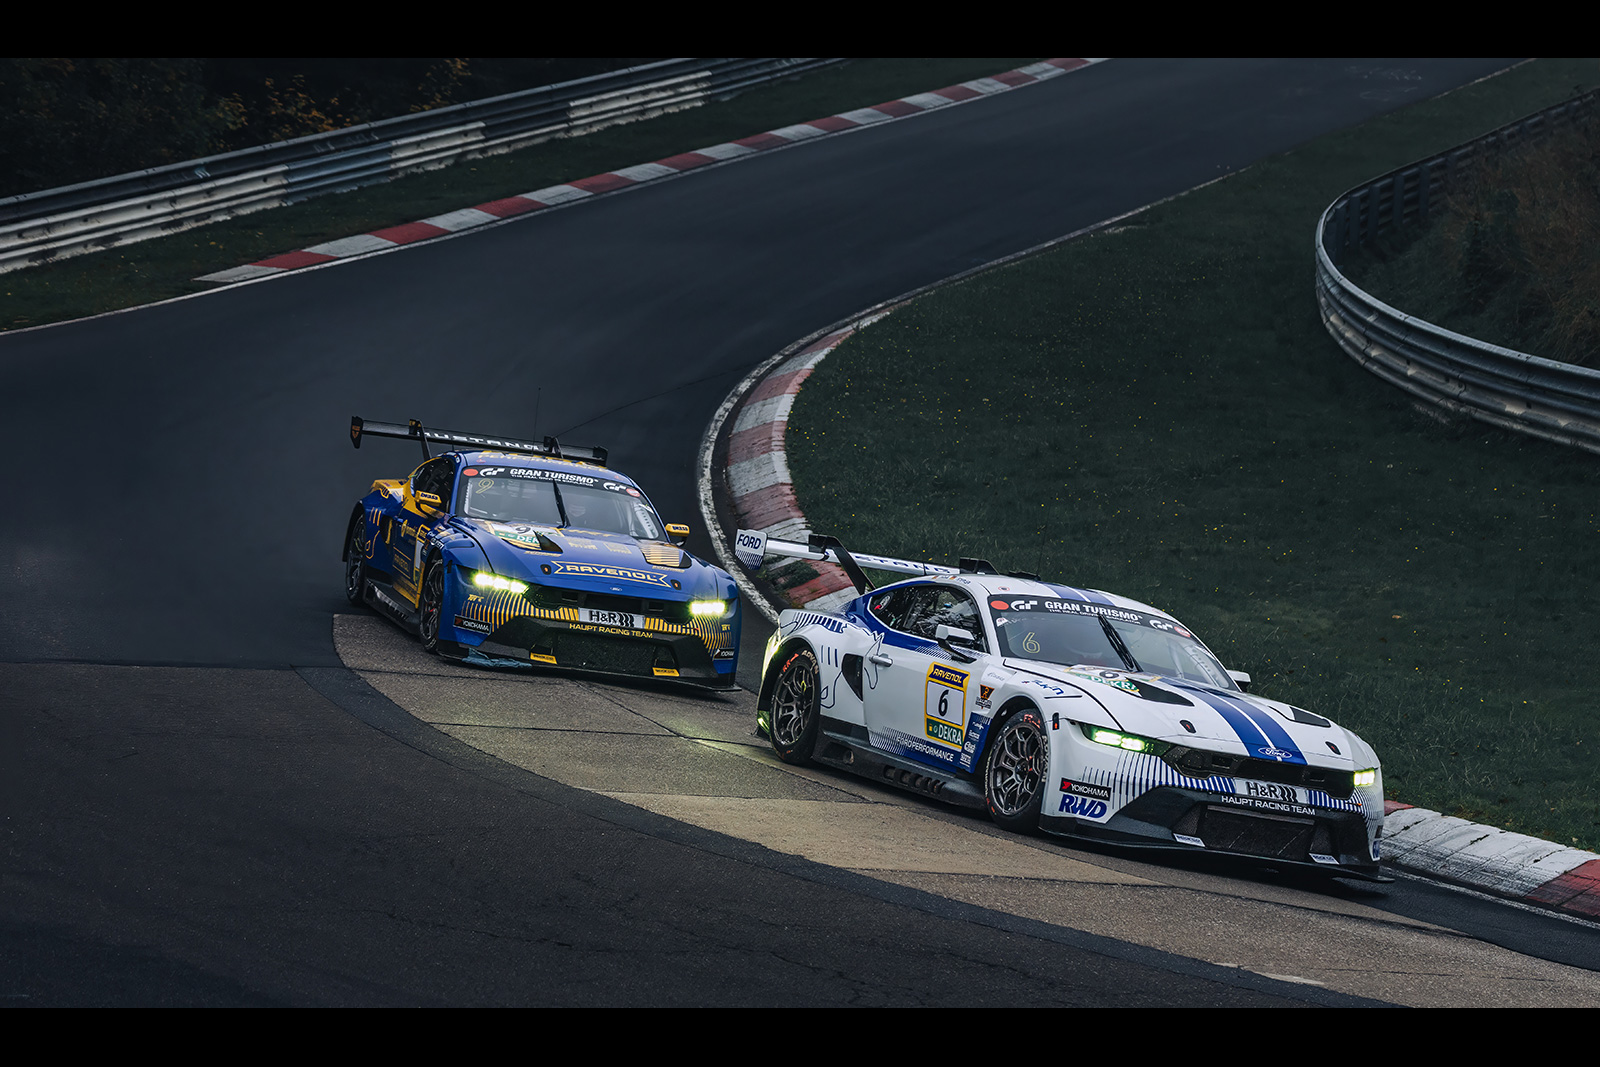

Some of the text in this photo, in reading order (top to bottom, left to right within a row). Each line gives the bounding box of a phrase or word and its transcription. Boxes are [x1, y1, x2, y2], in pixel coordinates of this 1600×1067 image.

[509, 468, 542, 477] GRAN
[475, 478, 495, 494] 9
[736, 533, 762, 550] FORD
[565, 564, 659, 582] RAVENOL
[853, 554, 951, 575] STANG
[1044, 600, 1081, 612] GRAN
[1082, 604, 1139, 621] TURISMO
[569, 622, 653, 639] HAUPT RACING TEAM
[1022, 631, 1041, 654] 6
[932, 668, 963, 684] RAVENOL
[937, 689, 950, 717] 6
[938, 724, 963, 745] DEKRA
[1070, 782, 1110, 798] YOKOHAMA
[1058, 793, 1108, 819] RWD
[1220, 795, 1316, 816] HAUPT RACING TEAM
